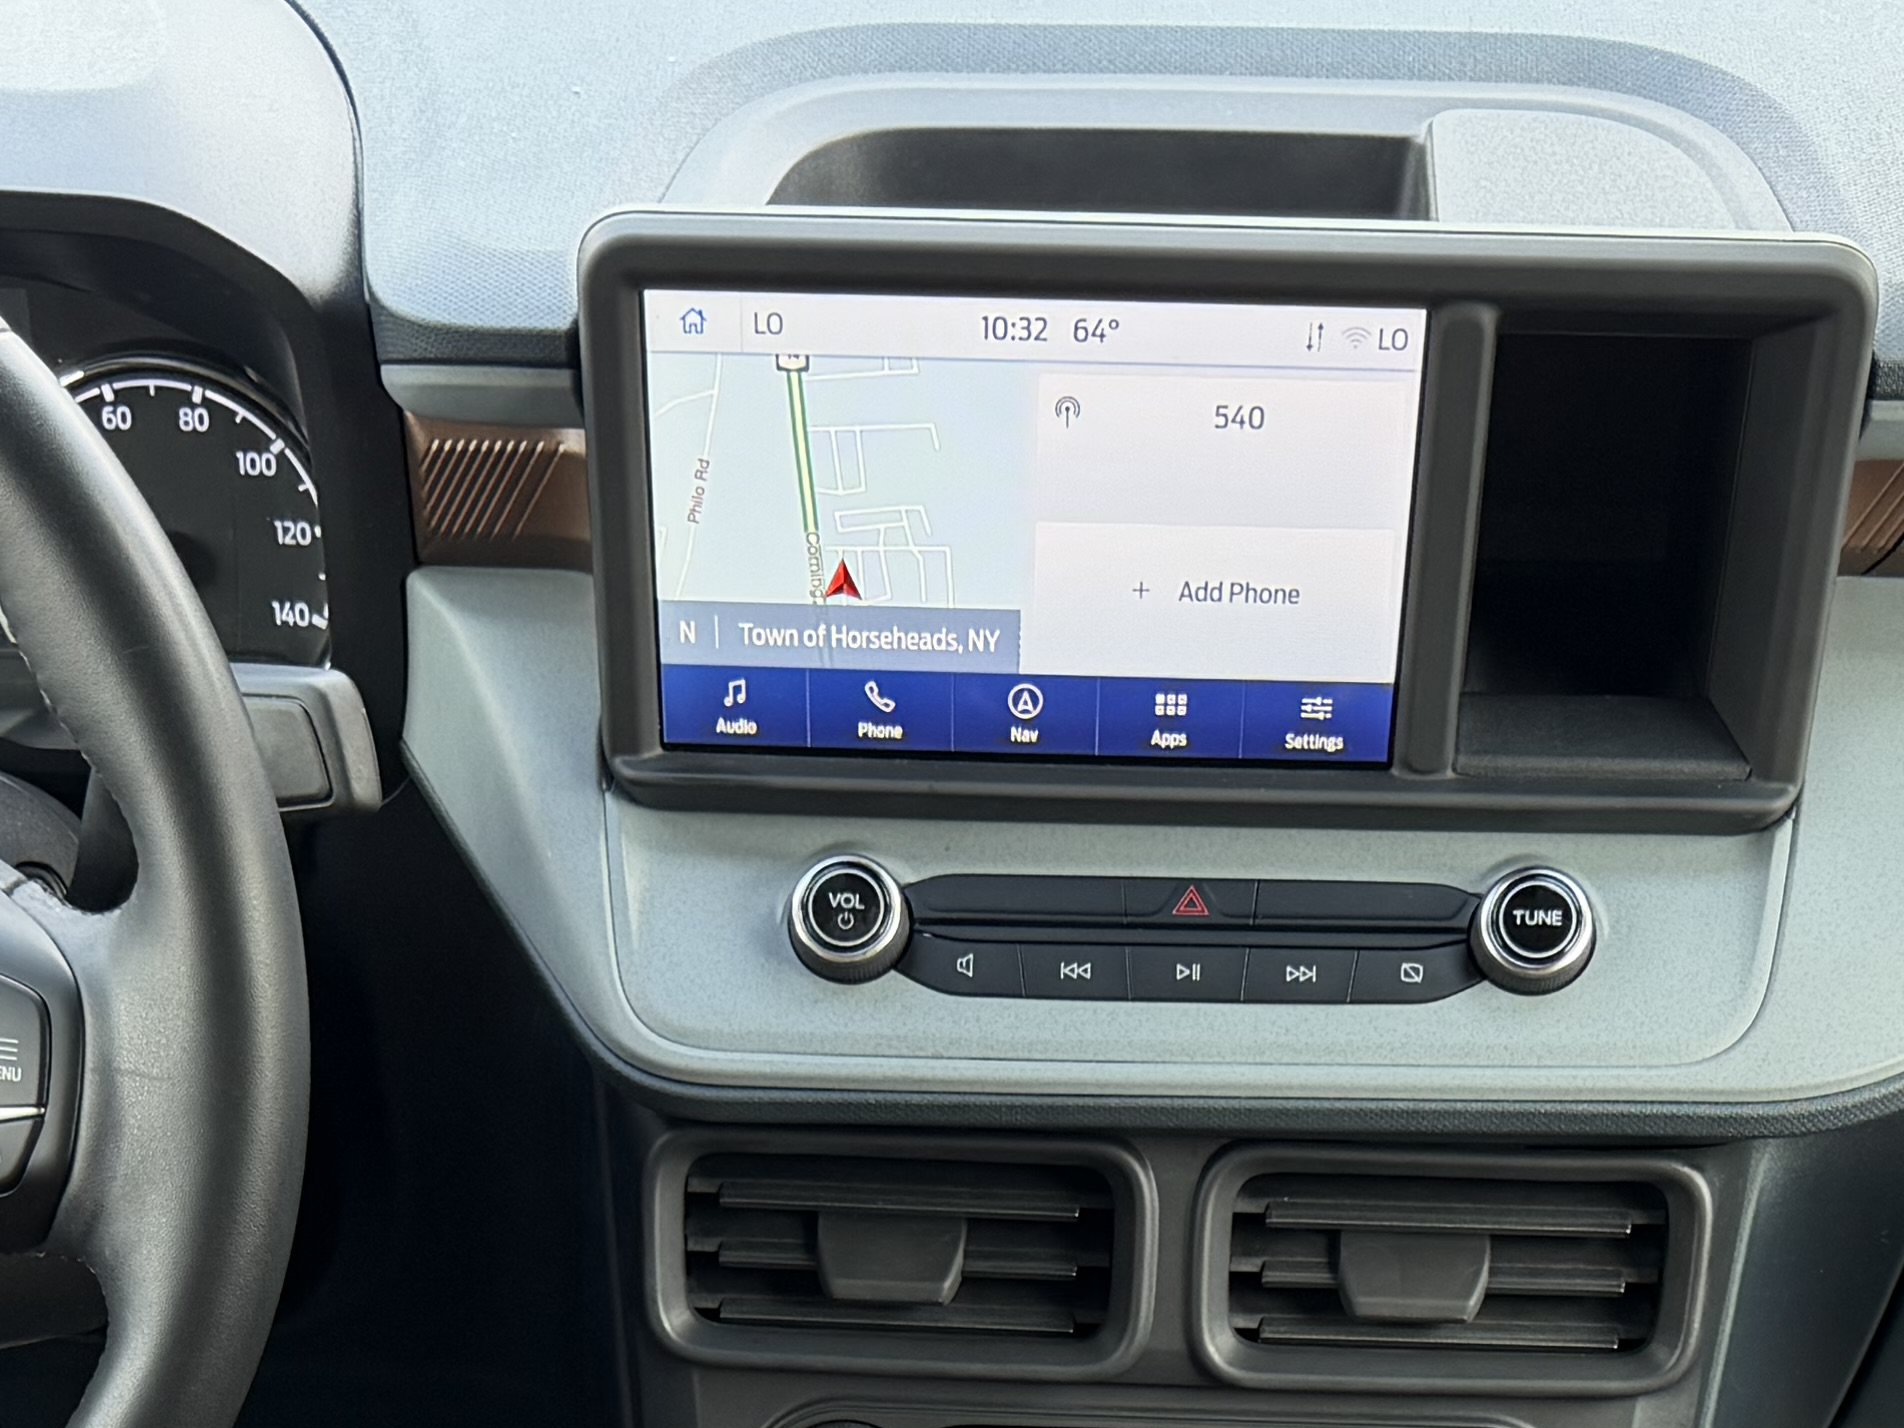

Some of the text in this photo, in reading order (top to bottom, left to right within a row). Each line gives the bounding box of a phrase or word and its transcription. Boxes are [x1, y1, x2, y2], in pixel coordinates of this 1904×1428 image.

[752, 312, 785, 337] LO
[980, 314, 1121, 345] 10:32 64°
[1378, 327, 1409, 352] LO
[101, 405, 132, 431] 60
[178, 407, 210, 432] 80
[1213, 403, 1266, 432] 540
[235, 451, 277, 477] 100
[687, 458, 711, 525] Philo Rd
[273, 520, 312, 546] 120
[1178, 579, 1301, 607] Add Phone
[271, 600, 310, 627] 140
[679, 620, 696, 645] N
[738, 622, 1002, 655] Town of Horseheads, NY
[715, 716, 759, 738] Audio
[857, 719, 904, 741] Phone
[1009, 725, 1040, 745] Nav
[1150, 729, 1188, 753] Apps
[1284, 731, 1345, 755] Settings
[828, 892, 865, 909] VOL
[1512, 909, 1563, 926] TUNE
